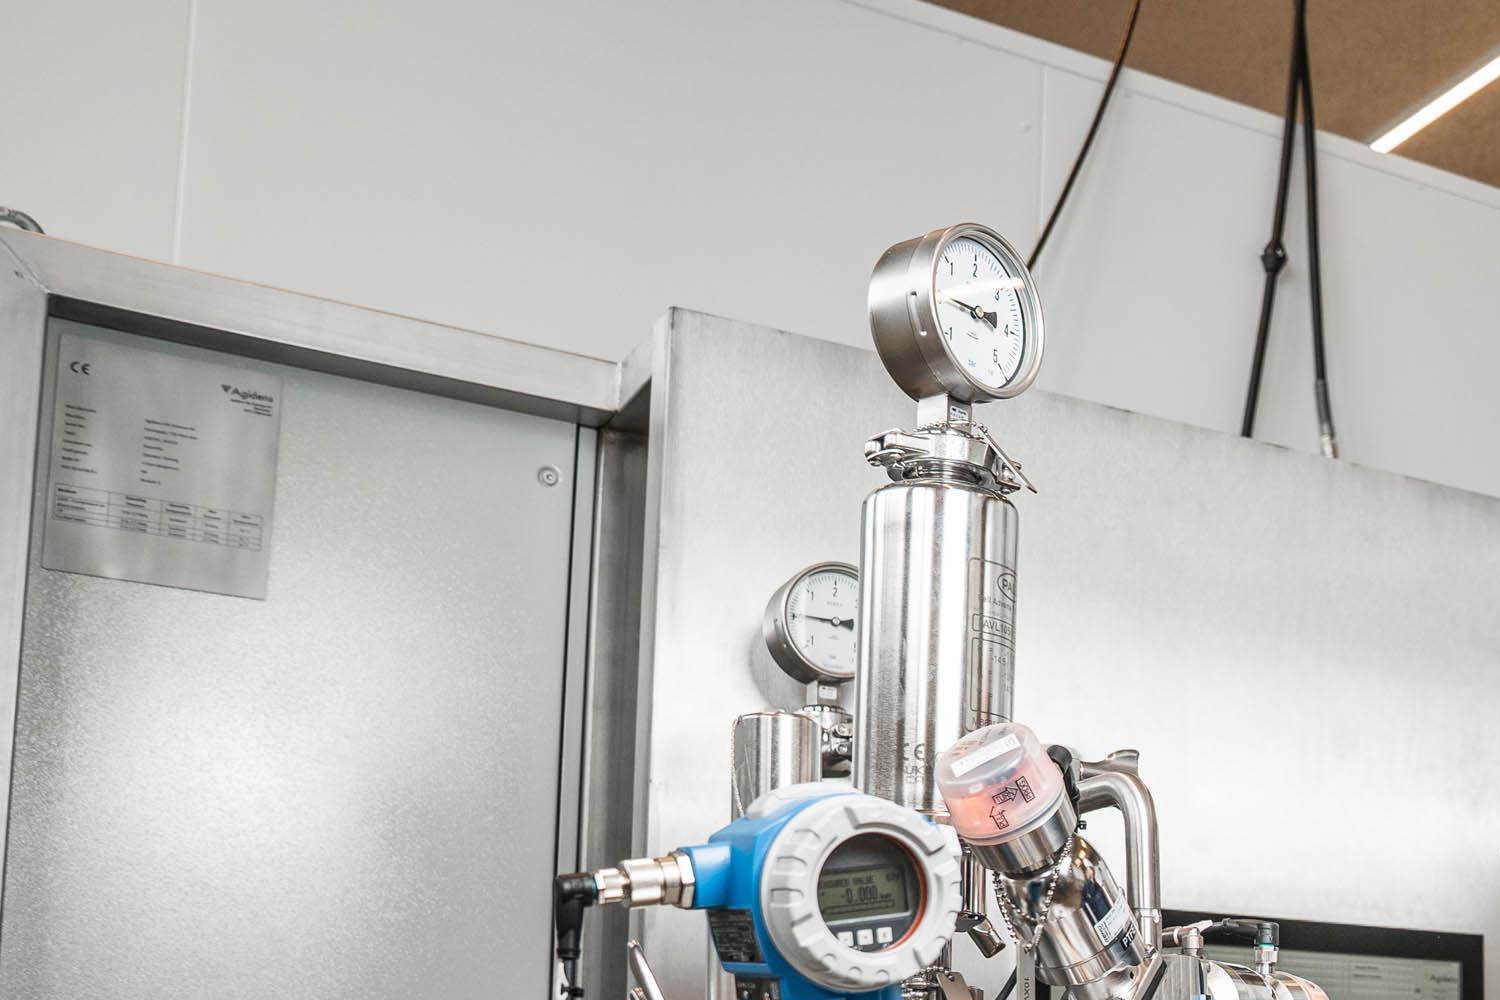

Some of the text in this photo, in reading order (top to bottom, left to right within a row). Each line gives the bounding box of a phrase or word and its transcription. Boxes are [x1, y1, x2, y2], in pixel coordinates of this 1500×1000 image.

[972, 263, 979, 278] 2
[1003, 323, 1010, 338] 4
[992, 349, 999, 363] 5
